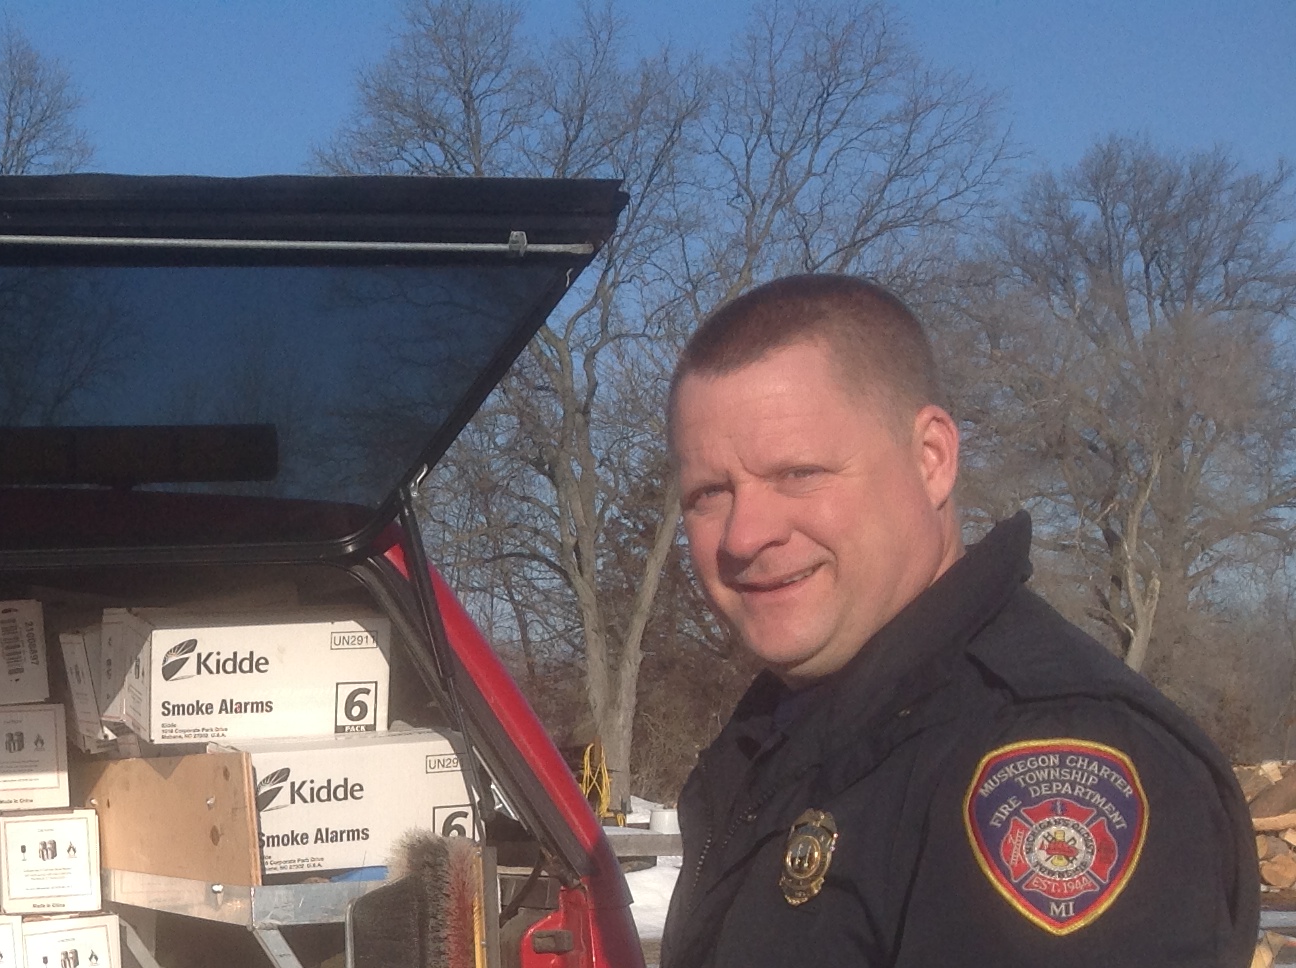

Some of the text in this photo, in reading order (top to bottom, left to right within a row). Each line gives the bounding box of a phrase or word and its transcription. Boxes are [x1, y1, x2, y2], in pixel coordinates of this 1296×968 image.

[333, 635, 376, 646] UN2911
[196, 651, 269, 675] Kidde
[161, 698, 273, 717] Smoke Alarms
[344, 687, 372, 722] 6
[428, 757, 460, 770] UN29
[978, 754, 1134, 798] MUSKEGON CHARTER
[1013, 768, 1099, 789] TOWNSHIP
[290, 777, 364, 805] Kidde
[989, 782, 1128, 831] FIRE DEPARTMENT
[442, 811, 469, 838] 6
[313, 827, 370, 845] Alarms
[1050, 901, 1075, 917] MI
